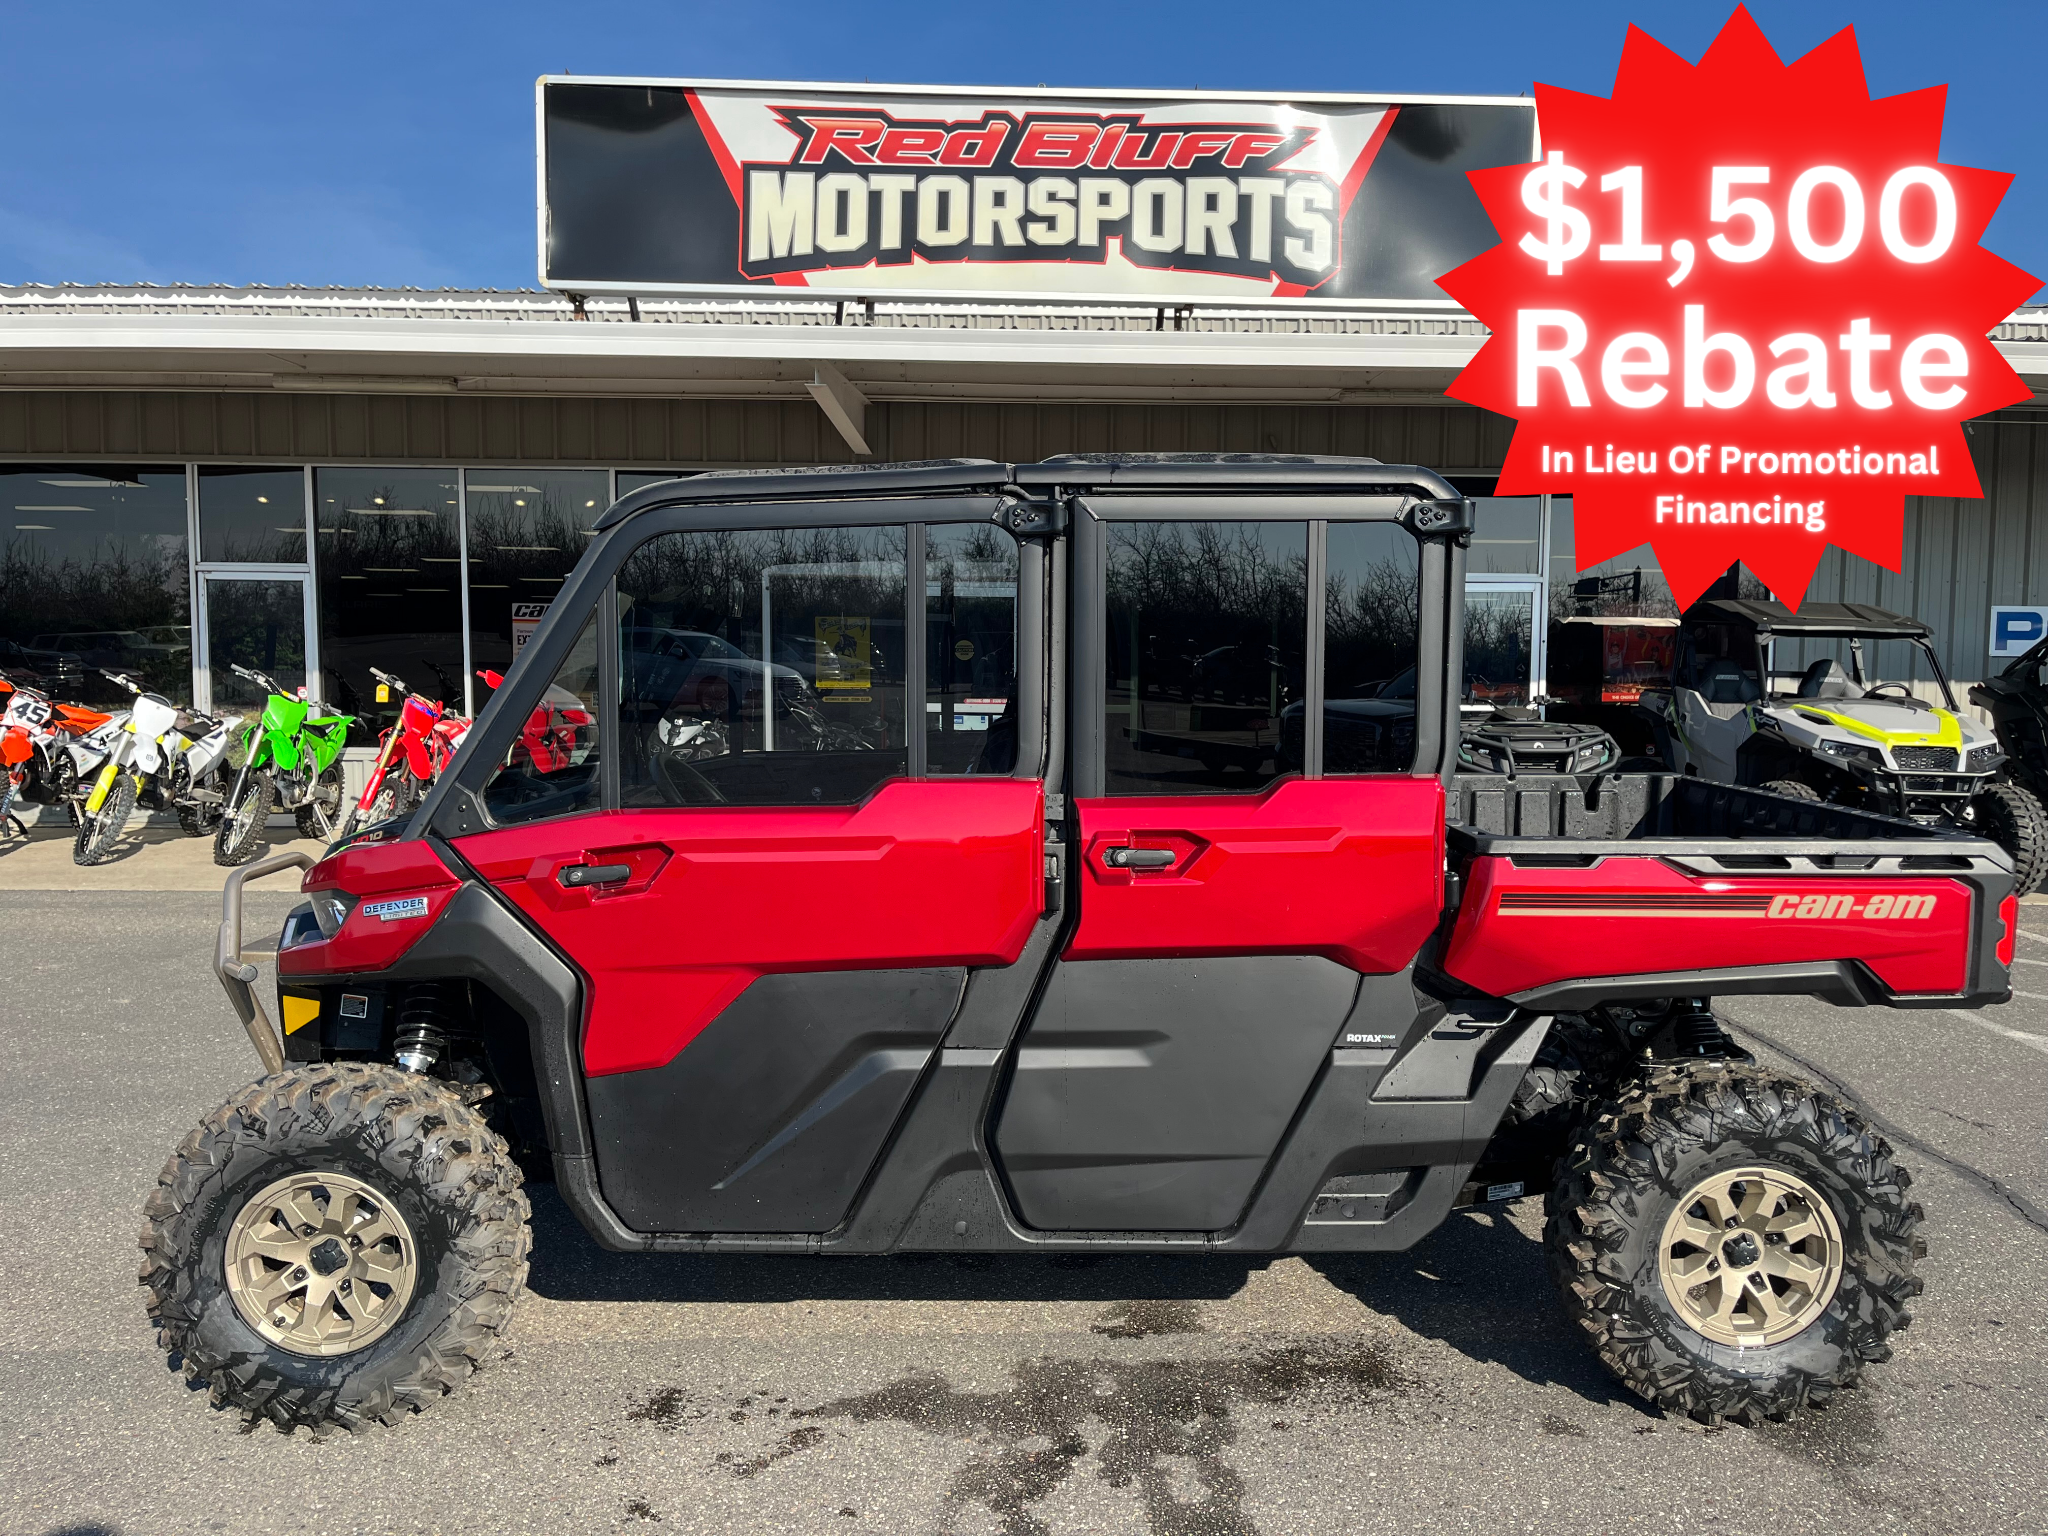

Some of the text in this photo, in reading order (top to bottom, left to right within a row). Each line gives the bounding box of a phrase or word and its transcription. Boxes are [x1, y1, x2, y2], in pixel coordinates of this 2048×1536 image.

[798, 116, 1295, 170] Red Bluff
[747, 171, 1335, 273] MOTORSPORTS
[1994, 611, 2048, 651] P
[14, 701, 48, 724] 45
[1753, 712, 1777, 726] XP
[364, 898, 424, 914] DEFENDER
[1767, 894, 1937, 919] can-am
[1346, 1033, 1382, 1043] ROTAX
